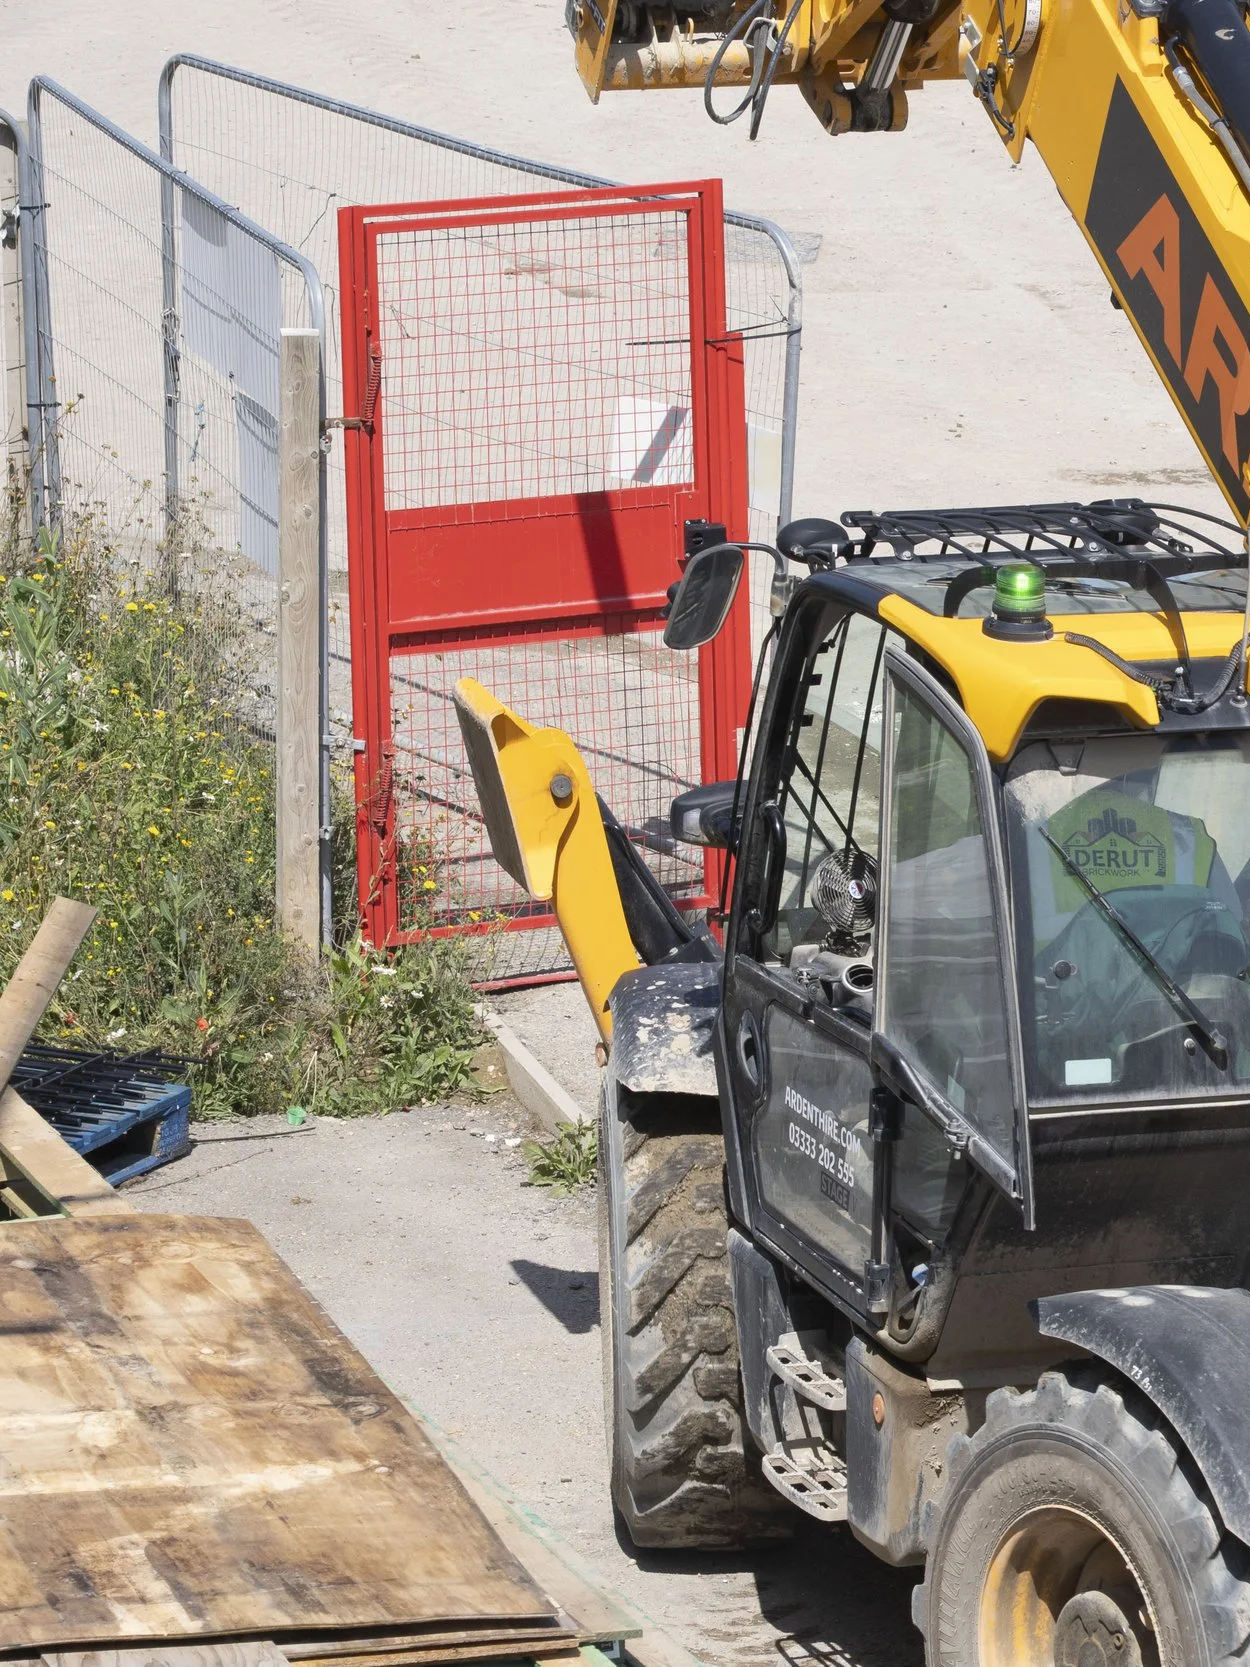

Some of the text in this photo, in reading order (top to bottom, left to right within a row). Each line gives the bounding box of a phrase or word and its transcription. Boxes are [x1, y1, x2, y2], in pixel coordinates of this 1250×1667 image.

[1074, 849, 1154, 868] DERUT
[784, 1086, 861, 1157] ARDENTHIRE.COM
[788, 1121, 855, 1188] 03333 202 555
[821, 1174, 849, 1209] STAGE
